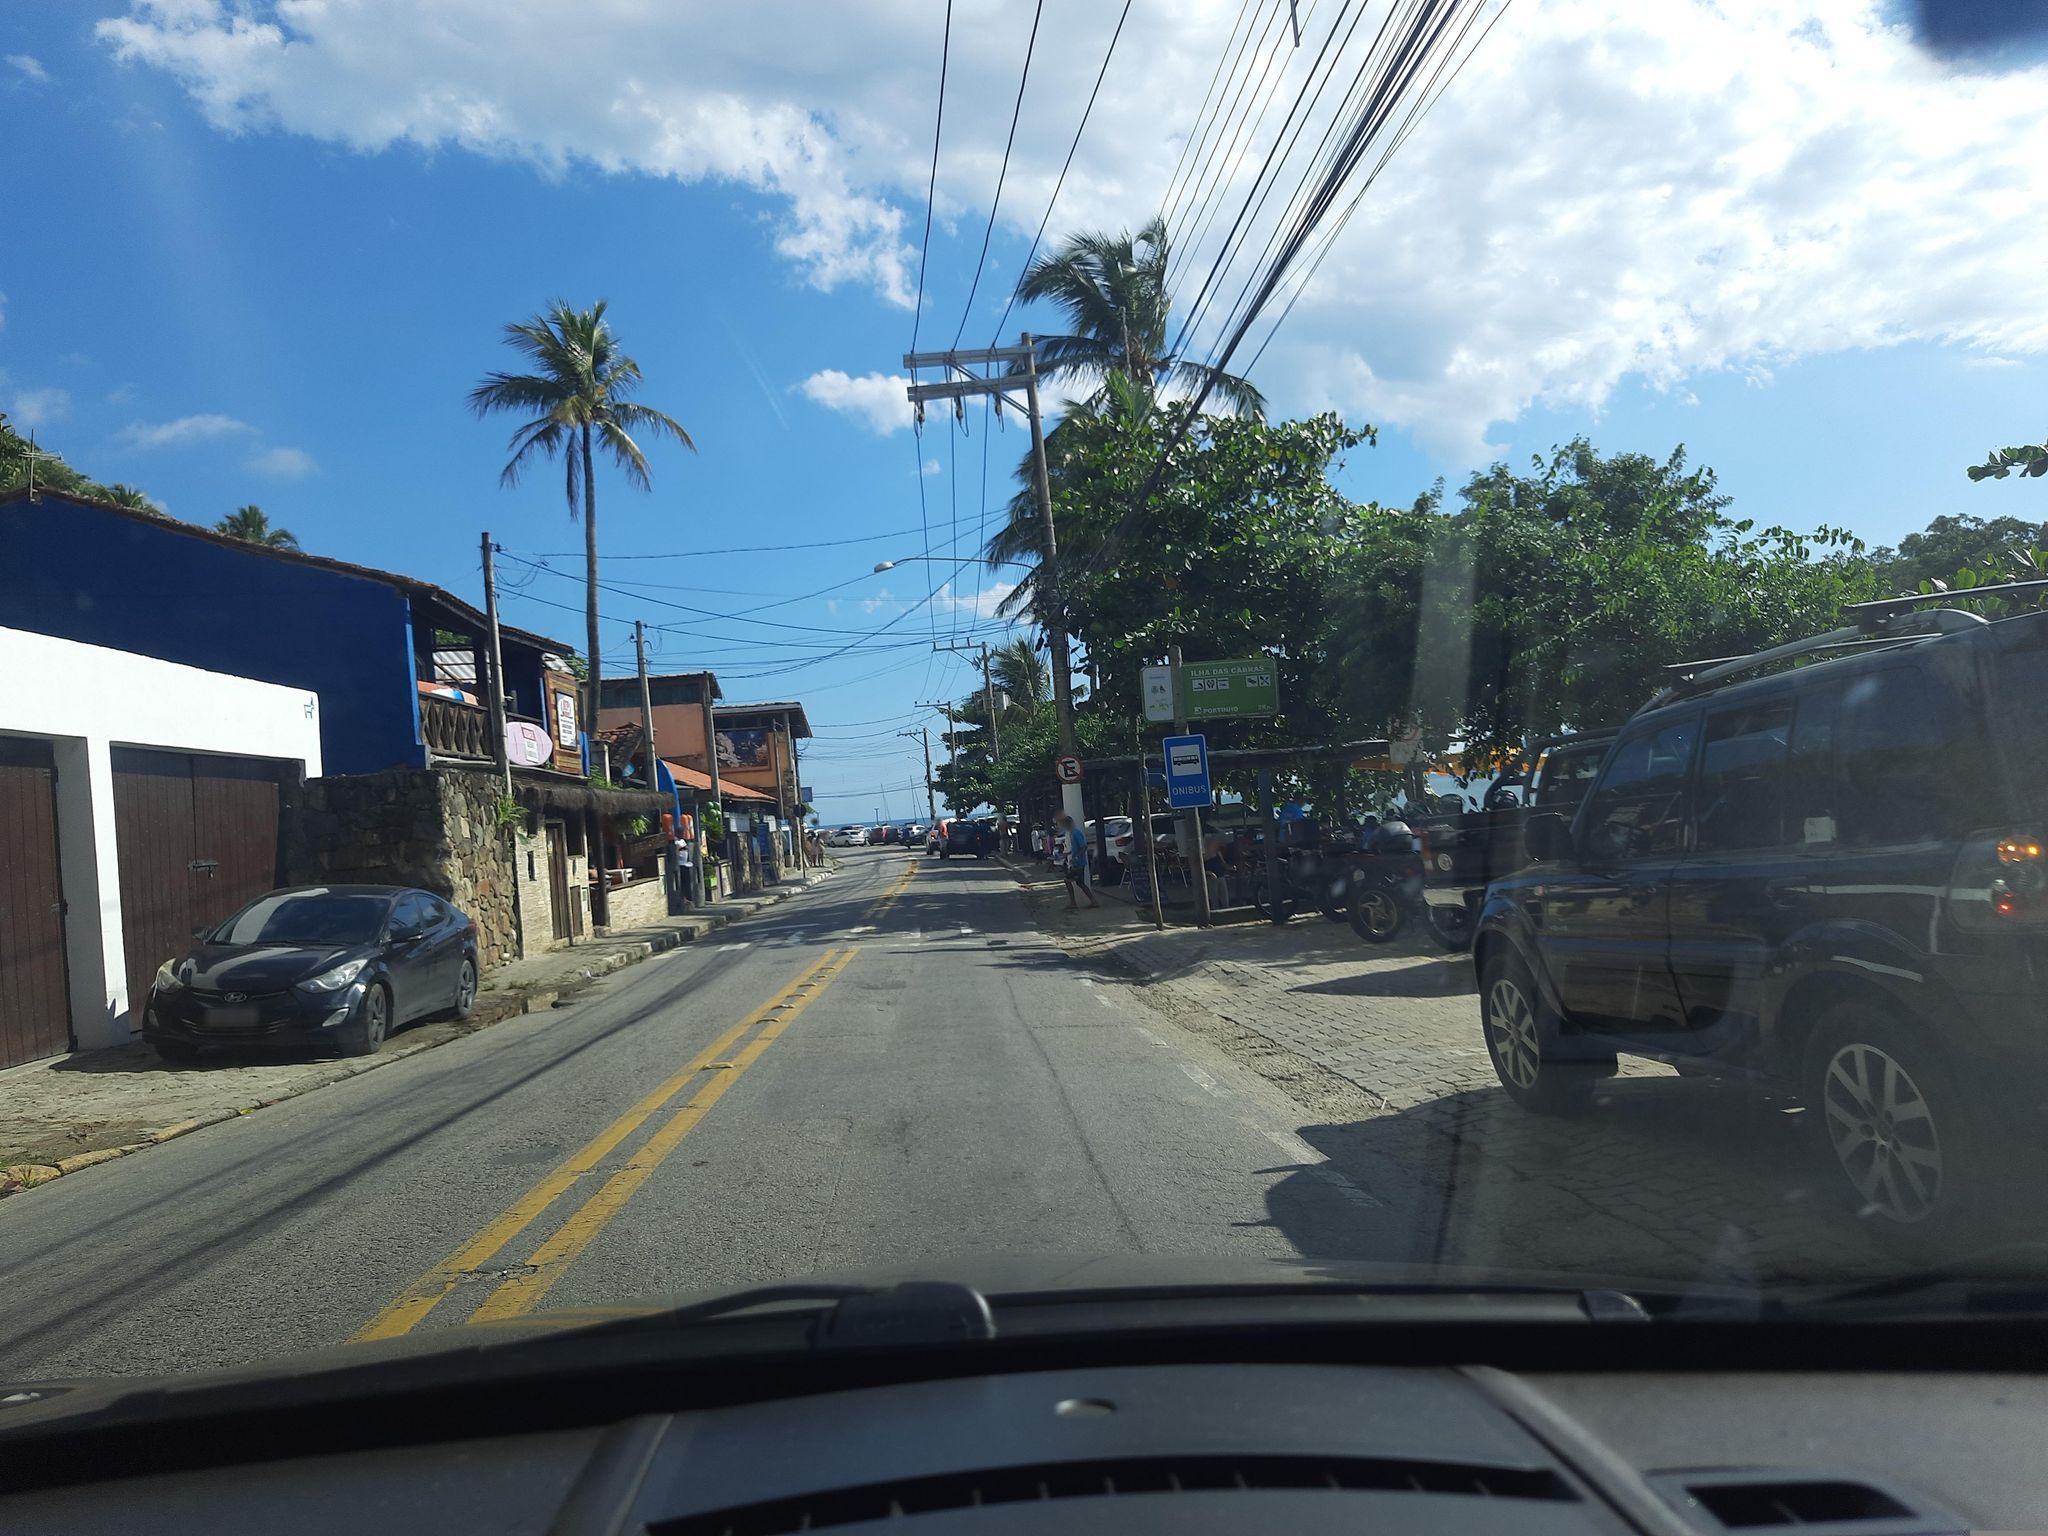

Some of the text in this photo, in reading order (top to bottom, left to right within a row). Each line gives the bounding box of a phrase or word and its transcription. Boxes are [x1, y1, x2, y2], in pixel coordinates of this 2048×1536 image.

[1191, 669, 1210, 677] ILHA
[1231, 666, 1265, 674] CABRAS
[1203, 706, 1239, 714] PORTINHO
